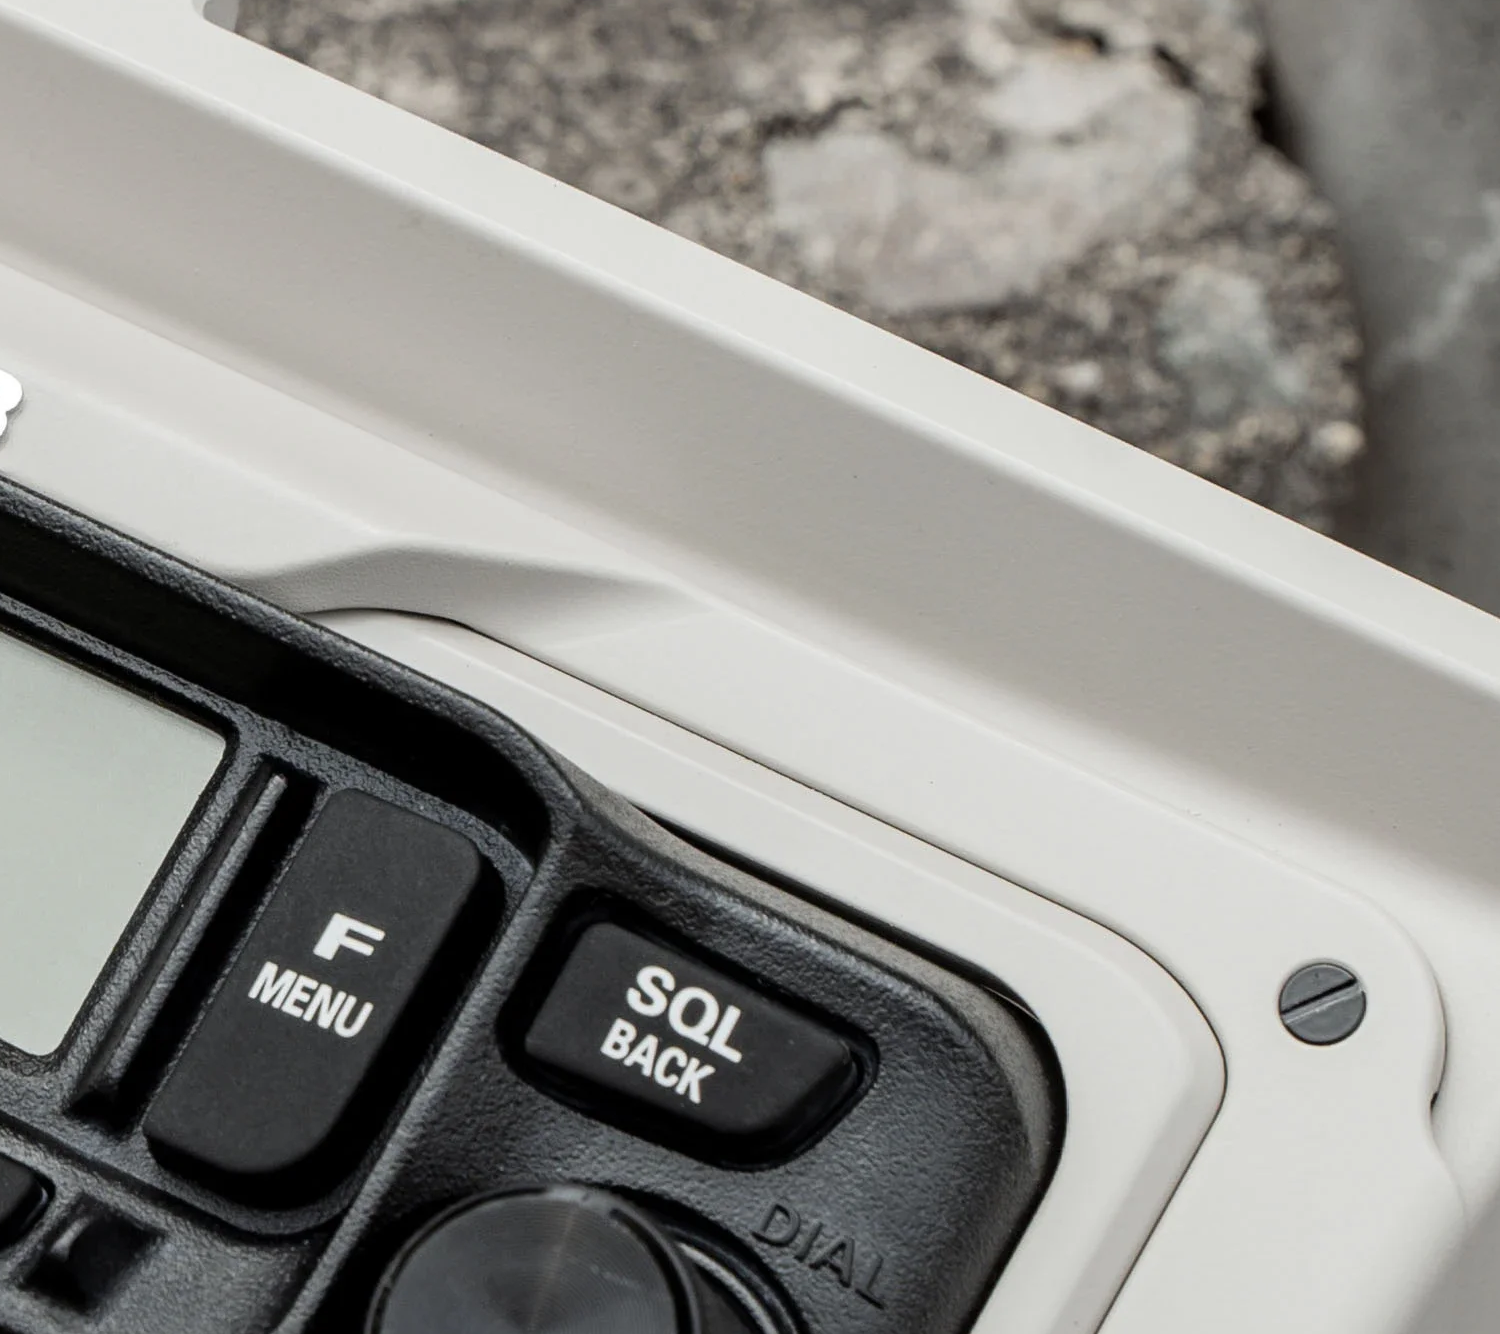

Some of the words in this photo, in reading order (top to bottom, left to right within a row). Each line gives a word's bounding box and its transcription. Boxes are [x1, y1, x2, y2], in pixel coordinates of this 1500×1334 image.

[312, 911, 386, 962] F
[247, 960, 375, 1040] MENU
[625, 964, 743, 1064] SQL
[599, 1017, 716, 1105] BACK
[749, 1201, 887, 1309] DIAL
